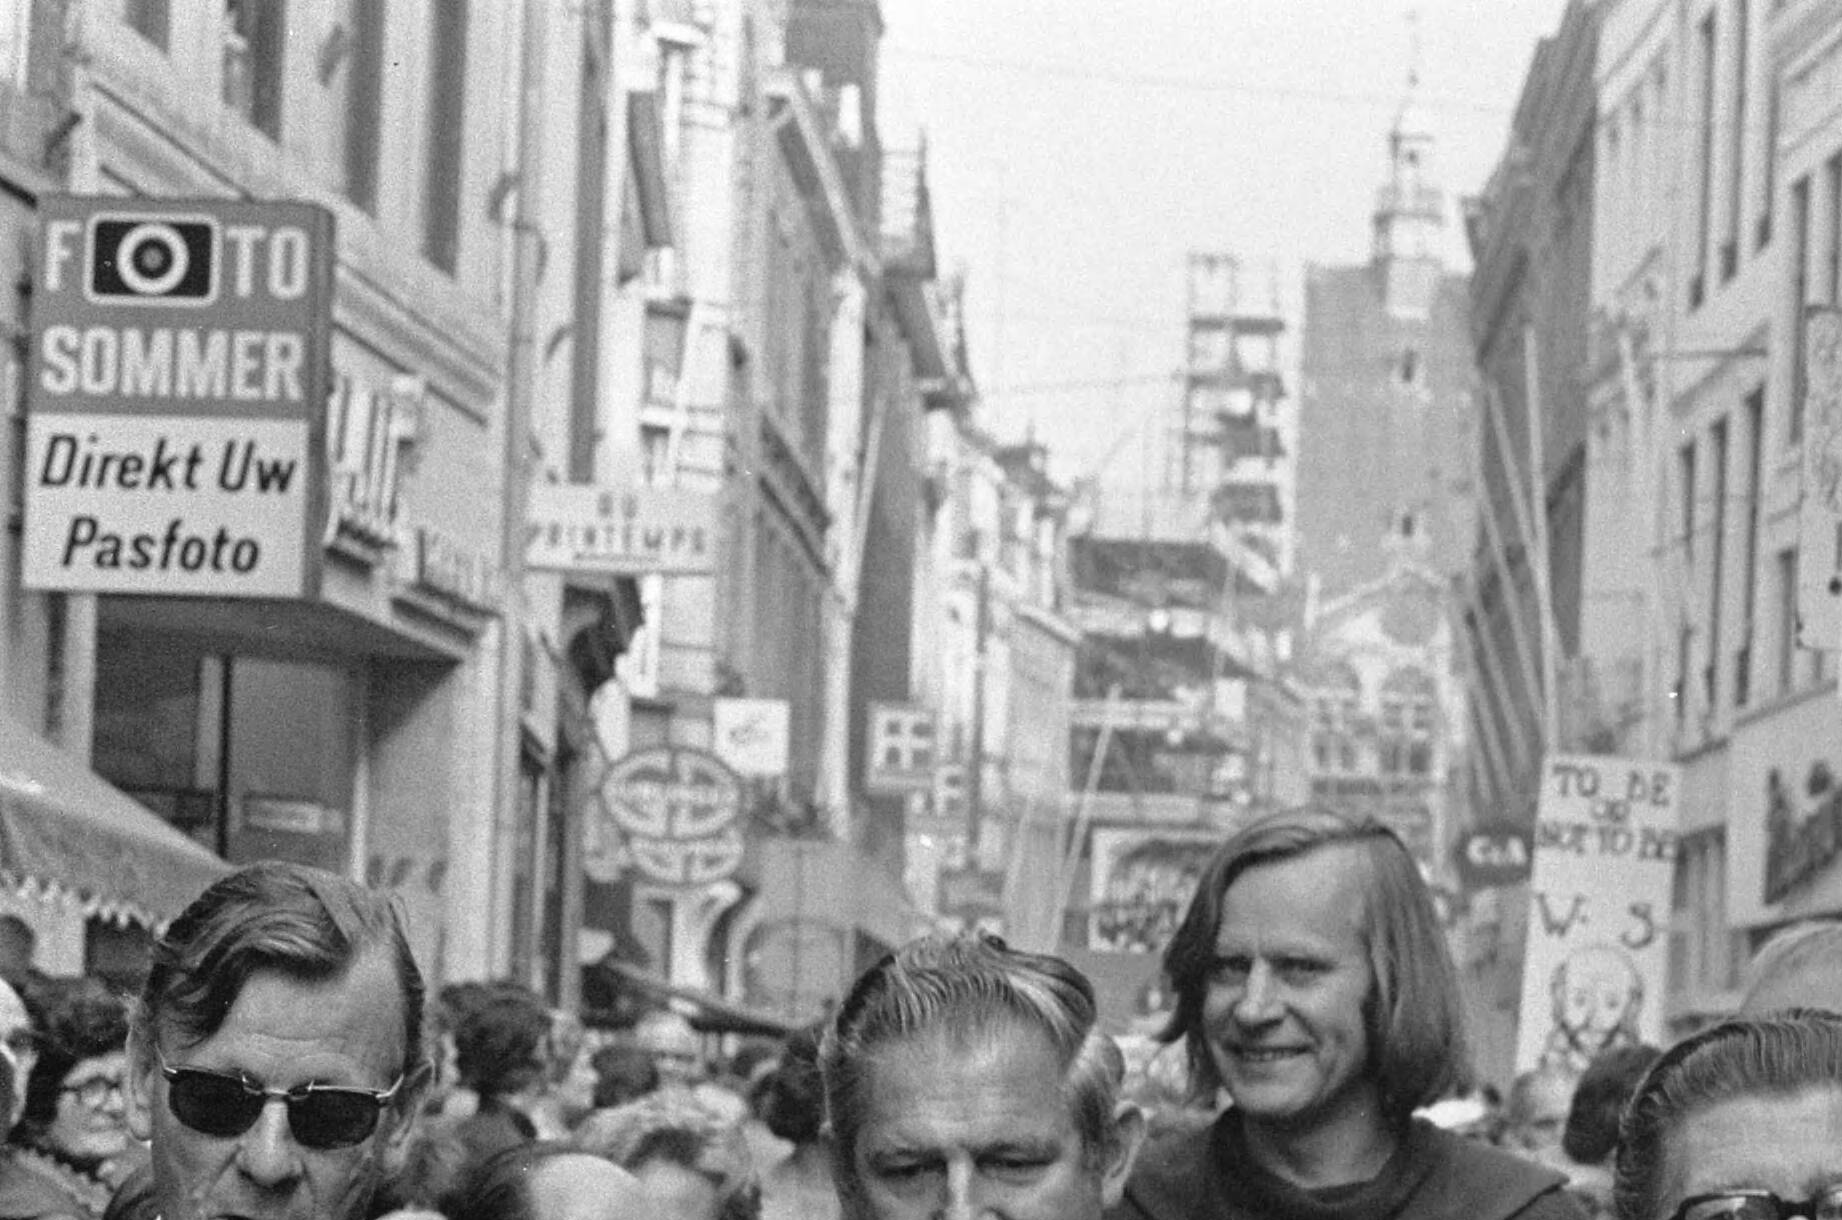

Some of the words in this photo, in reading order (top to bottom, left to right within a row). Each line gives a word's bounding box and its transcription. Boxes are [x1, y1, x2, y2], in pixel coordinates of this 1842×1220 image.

[46, 212, 308, 304] FOTO
[41, 325, 302, 400] SOMMER
[40, 432, 203, 490] Direkt
[219, 439, 295, 492] Uw
[62, 515, 259, 573] Pasfoto
[1552, 764, 1600, 798] TO
[1627, 772, 1671, 806] BE
[1597, 826, 1634, 855] TO
